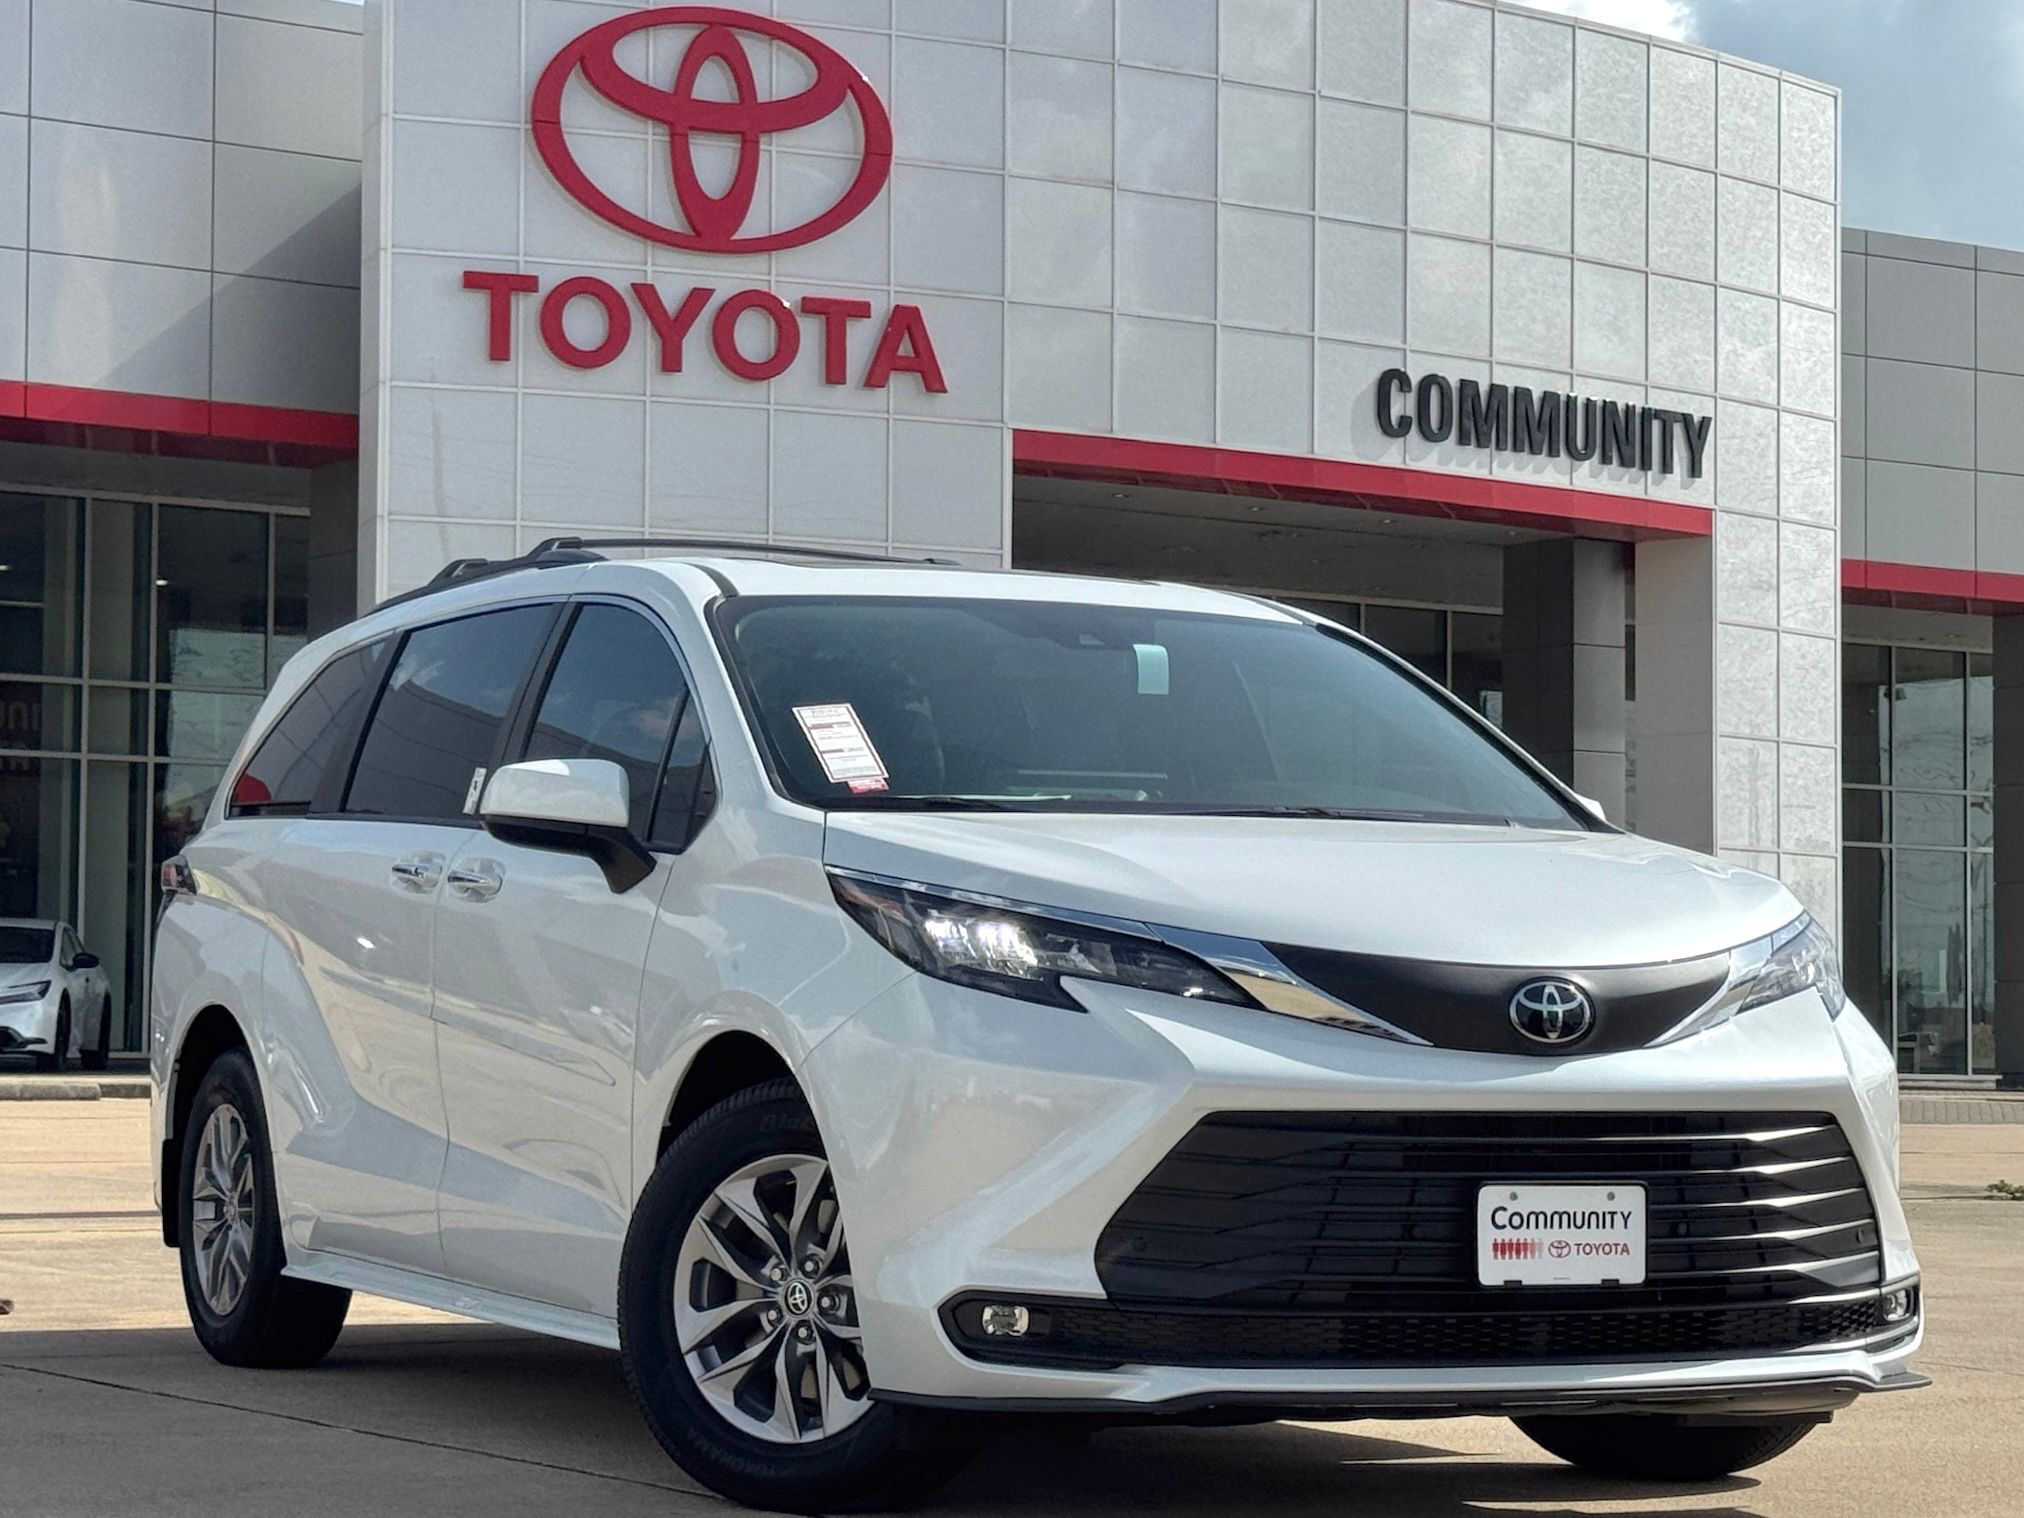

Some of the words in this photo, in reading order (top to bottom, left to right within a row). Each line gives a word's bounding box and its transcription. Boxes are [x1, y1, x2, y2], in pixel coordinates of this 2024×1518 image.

[462, 270, 948, 394] TOYOTA
[1377, 368, 1713, 479] COMMUNITY
[1574, 1242, 1630, 1256] TOYOTA
